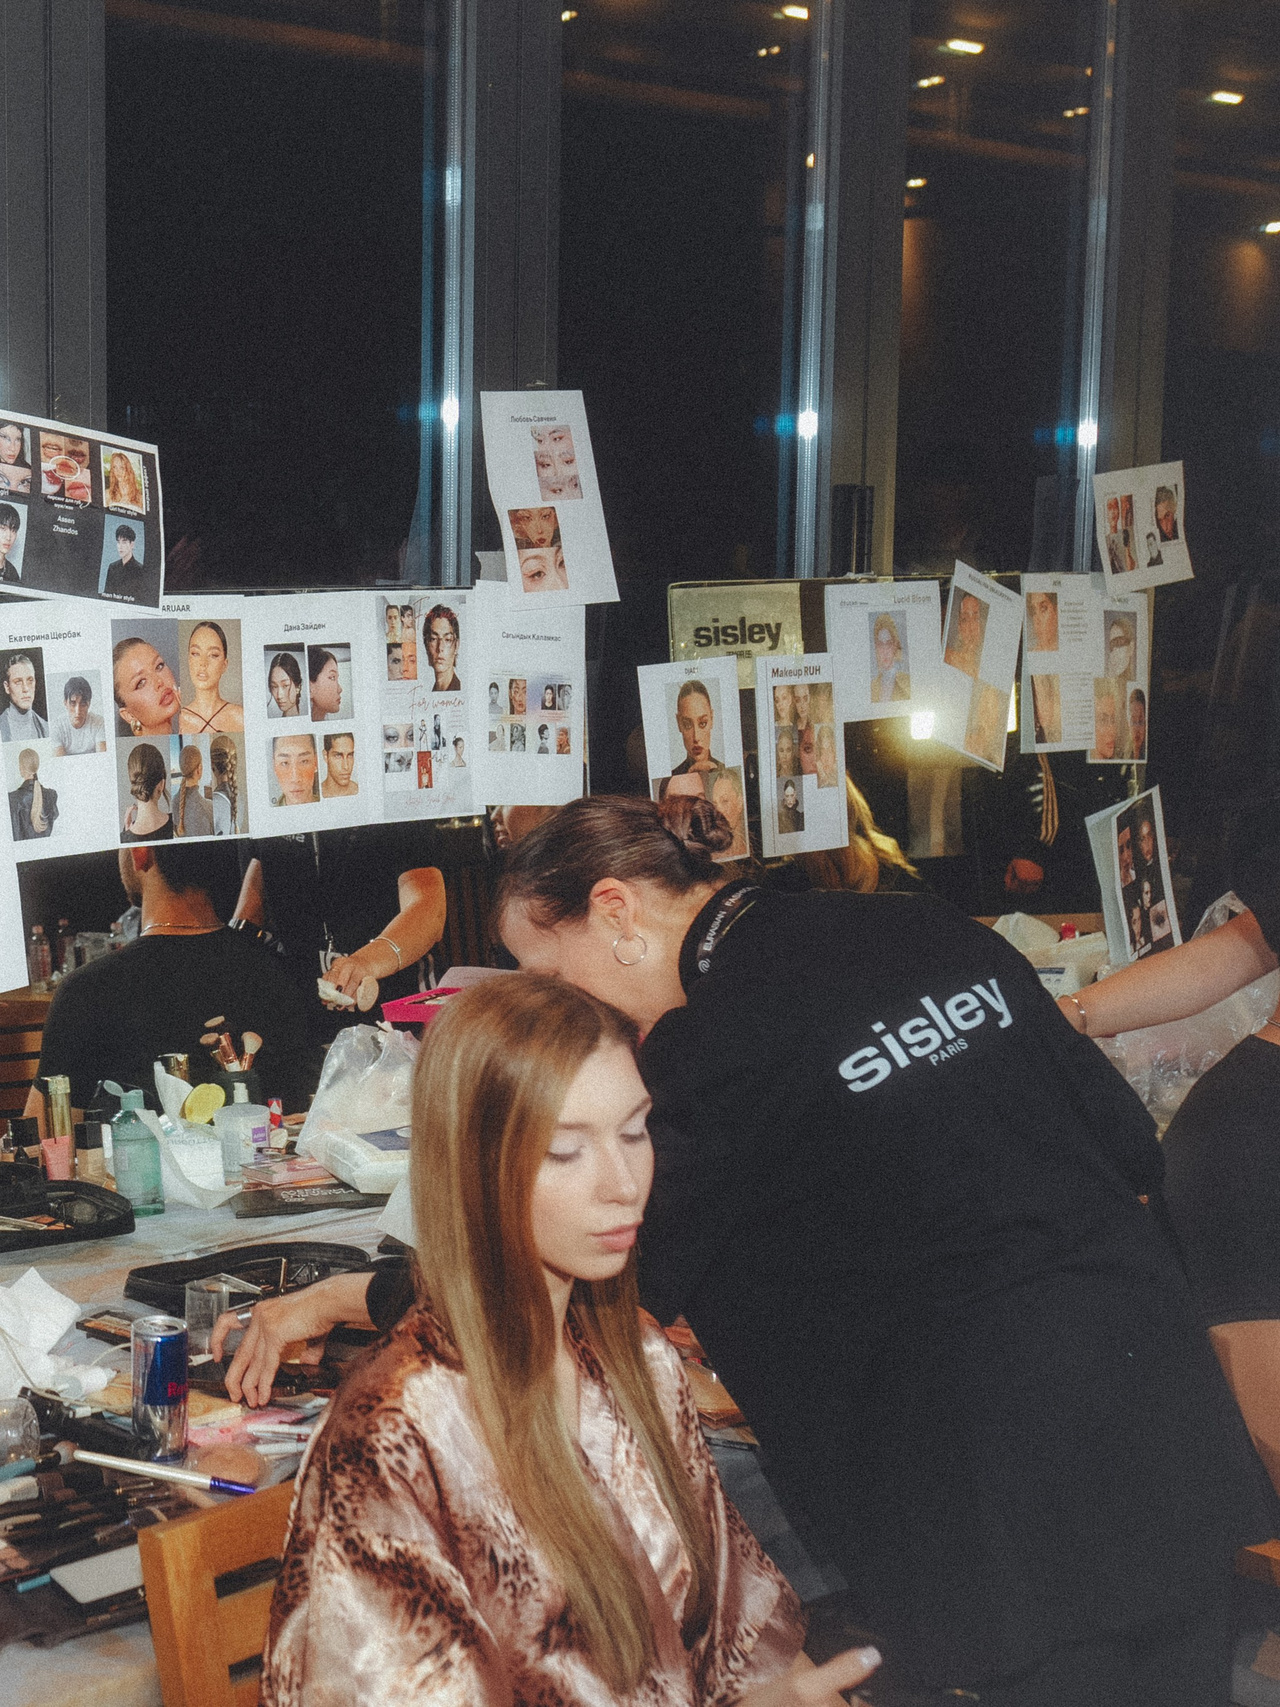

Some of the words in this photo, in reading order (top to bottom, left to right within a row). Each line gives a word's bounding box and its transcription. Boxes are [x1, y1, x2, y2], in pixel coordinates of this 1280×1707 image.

[57, 515, 75, 524] Assen
[53, 524, 78, 535] Zhandos
[283, 624, 300, 632] Дана
[300, 622, 326, 631] Зайден
[694, 616, 782, 651] sisley
[8, 634, 50, 643] Екатерина
[50, 631, 81, 640] Щербак
[771, 667, 803, 678] Makeup
[803, 665, 821, 676] RUH
[702, 910, 727, 952] EURASIAN
[838, 978, 1014, 1093] sisley
[929, 1038, 969, 1067] PARIS
